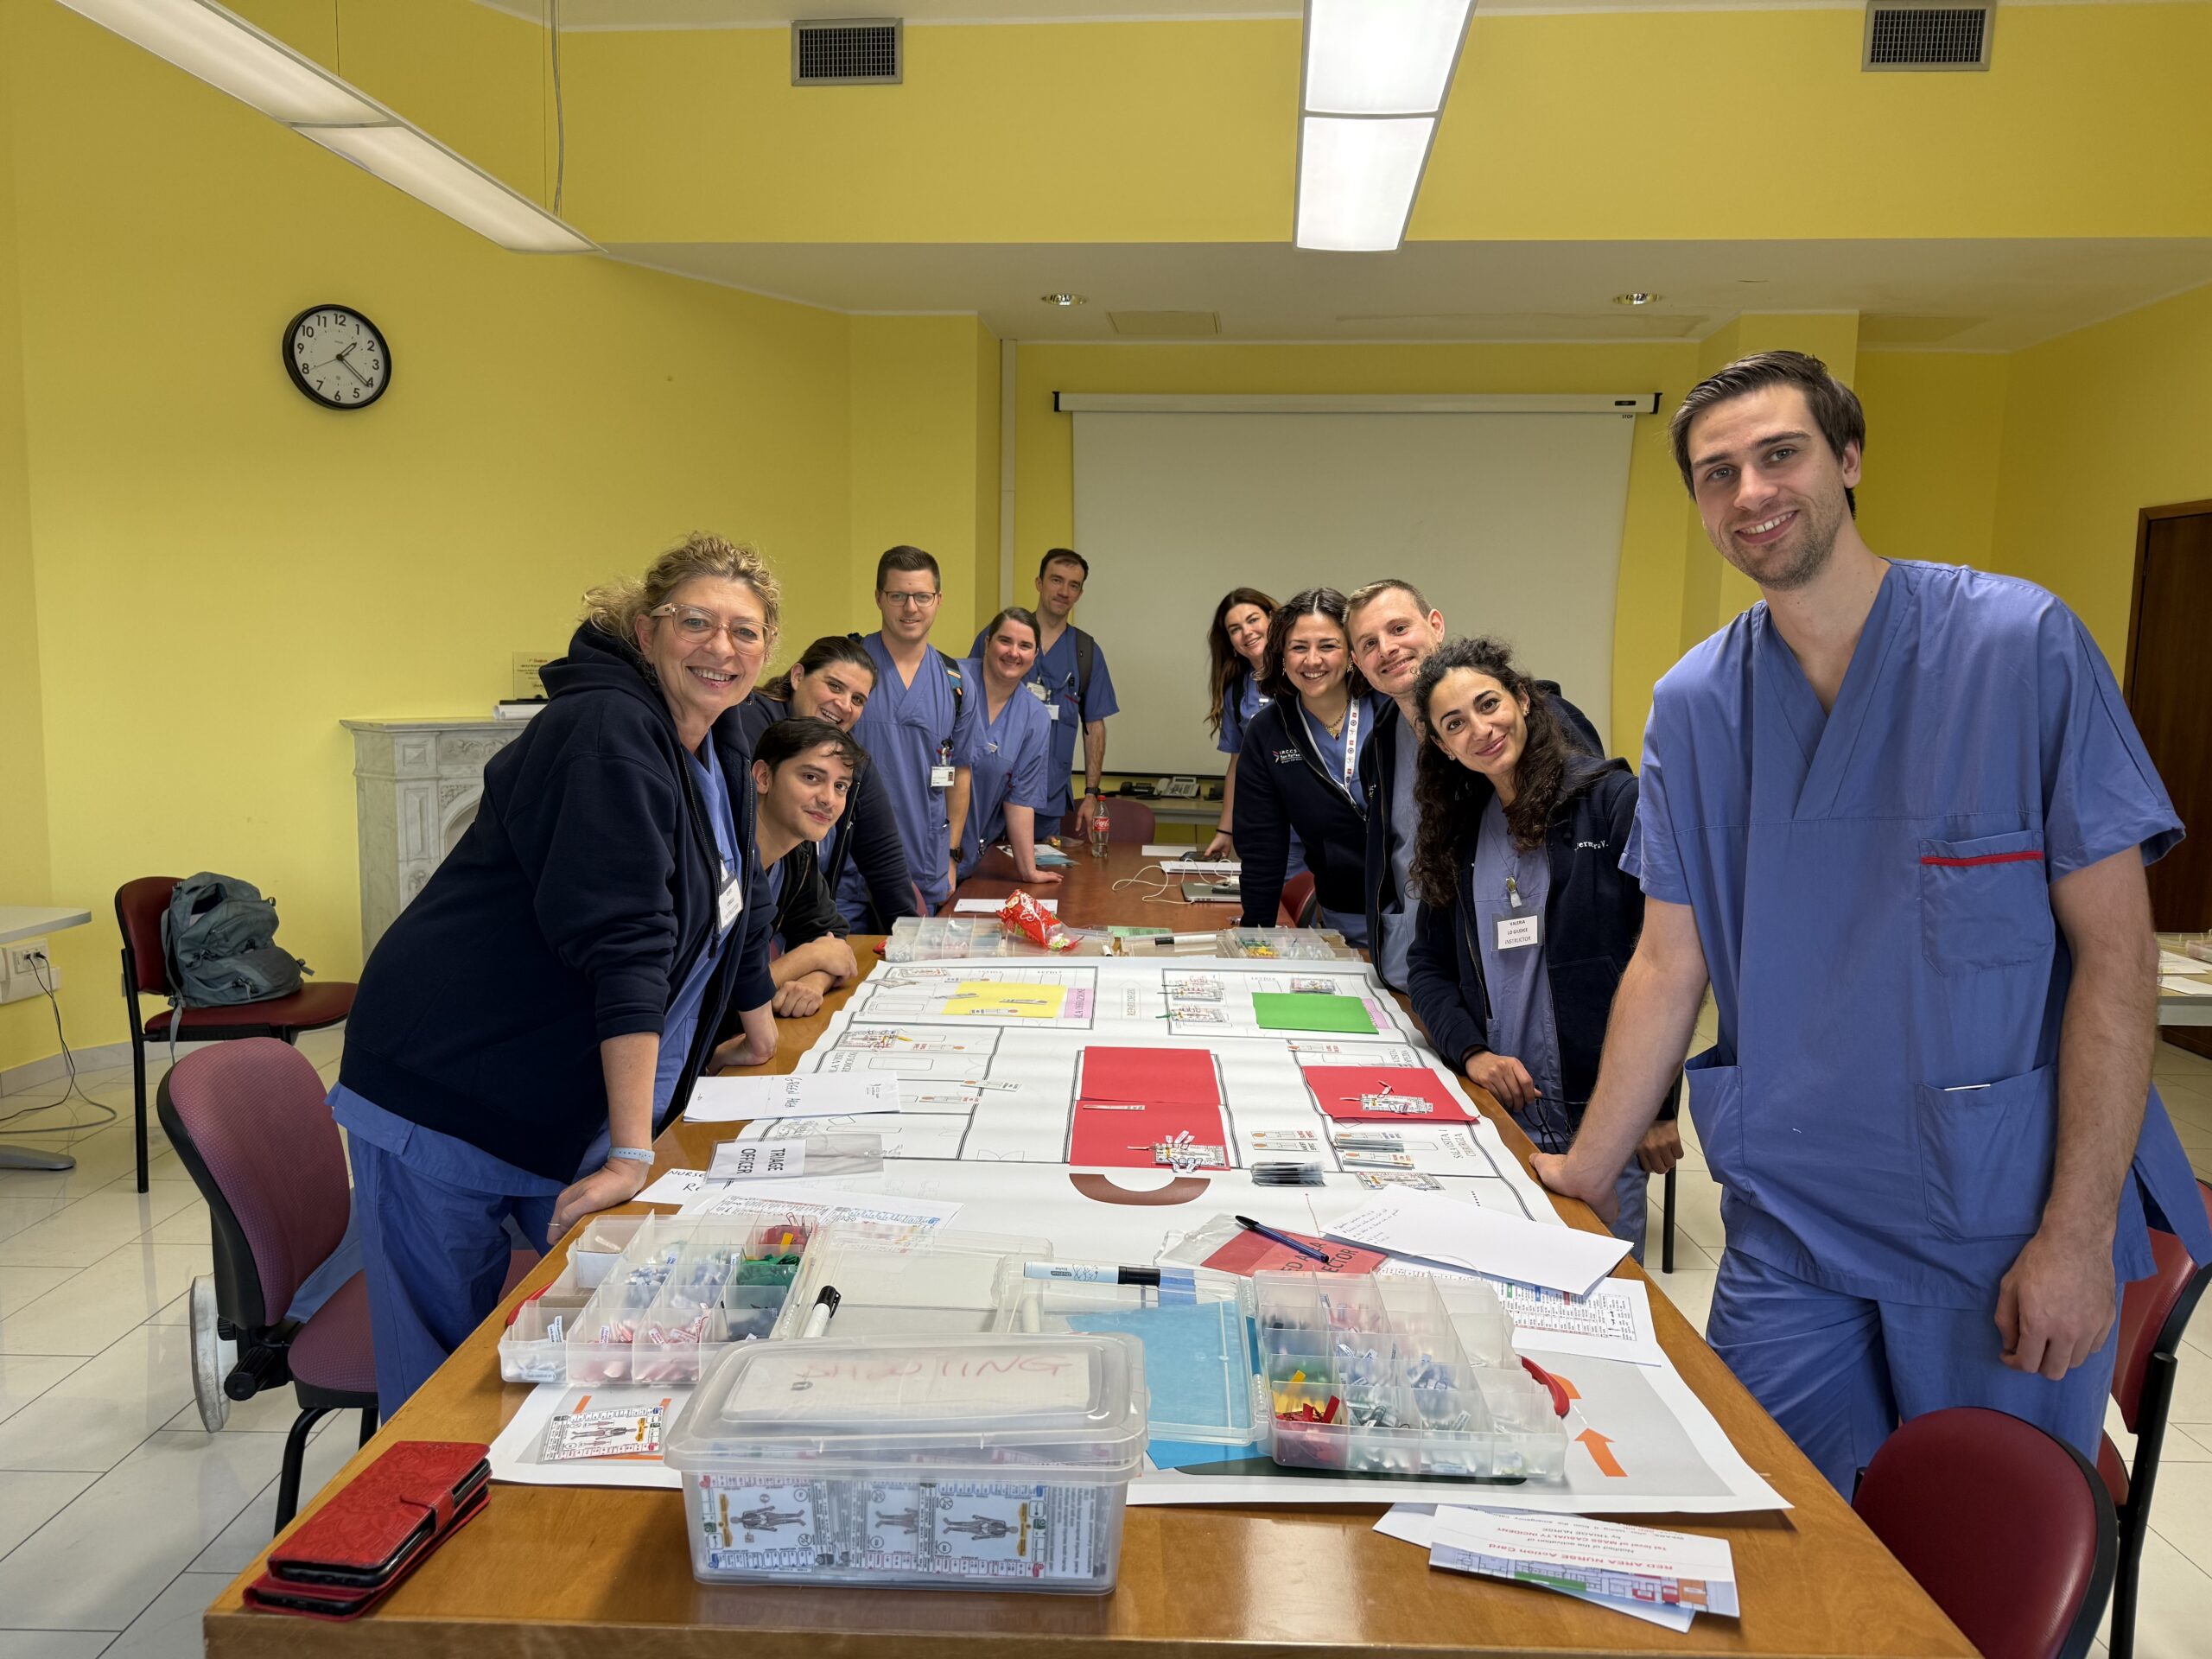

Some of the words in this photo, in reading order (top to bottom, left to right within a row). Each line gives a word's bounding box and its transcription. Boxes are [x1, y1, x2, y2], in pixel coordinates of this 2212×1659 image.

[316, 315, 327, 327] 11
[334, 313, 346, 327] 12
[302, 325, 314, 338] 10
[355, 324, 359, 335] 1
[297, 343, 304, 354] 9
[367, 340, 375, 352] 2
[302, 363, 309, 374] 8
[372, 359, 379, 370] 3
[316, 380, 323, 391] 7
[367, 377, 373, 388] 4
[334, 391, 341, 401] 6
[353, 388, 359, 398] 5
[1505, 936, 1531, 944] INSTRUCTOR
[736, 1148, 756, 1174] OFFICER
[767, 1147, 785, 1172] TRIAGE
[1497, 1527, 1540, 1536] INCIDENT
[1575, 1529, 1610, 1538] TRIAGE
[1541, 1533, 1589, 1542] CASUALTY
[1488, 1543, 1516, 1552] Card
[1605, 1545, 1635, 1554] Notified
[1519, 1549, 1557, 1558] Action
[1561, 1554, 1604, 1563] NURSE
[1608, 1559, 1643, 1567] AREA
